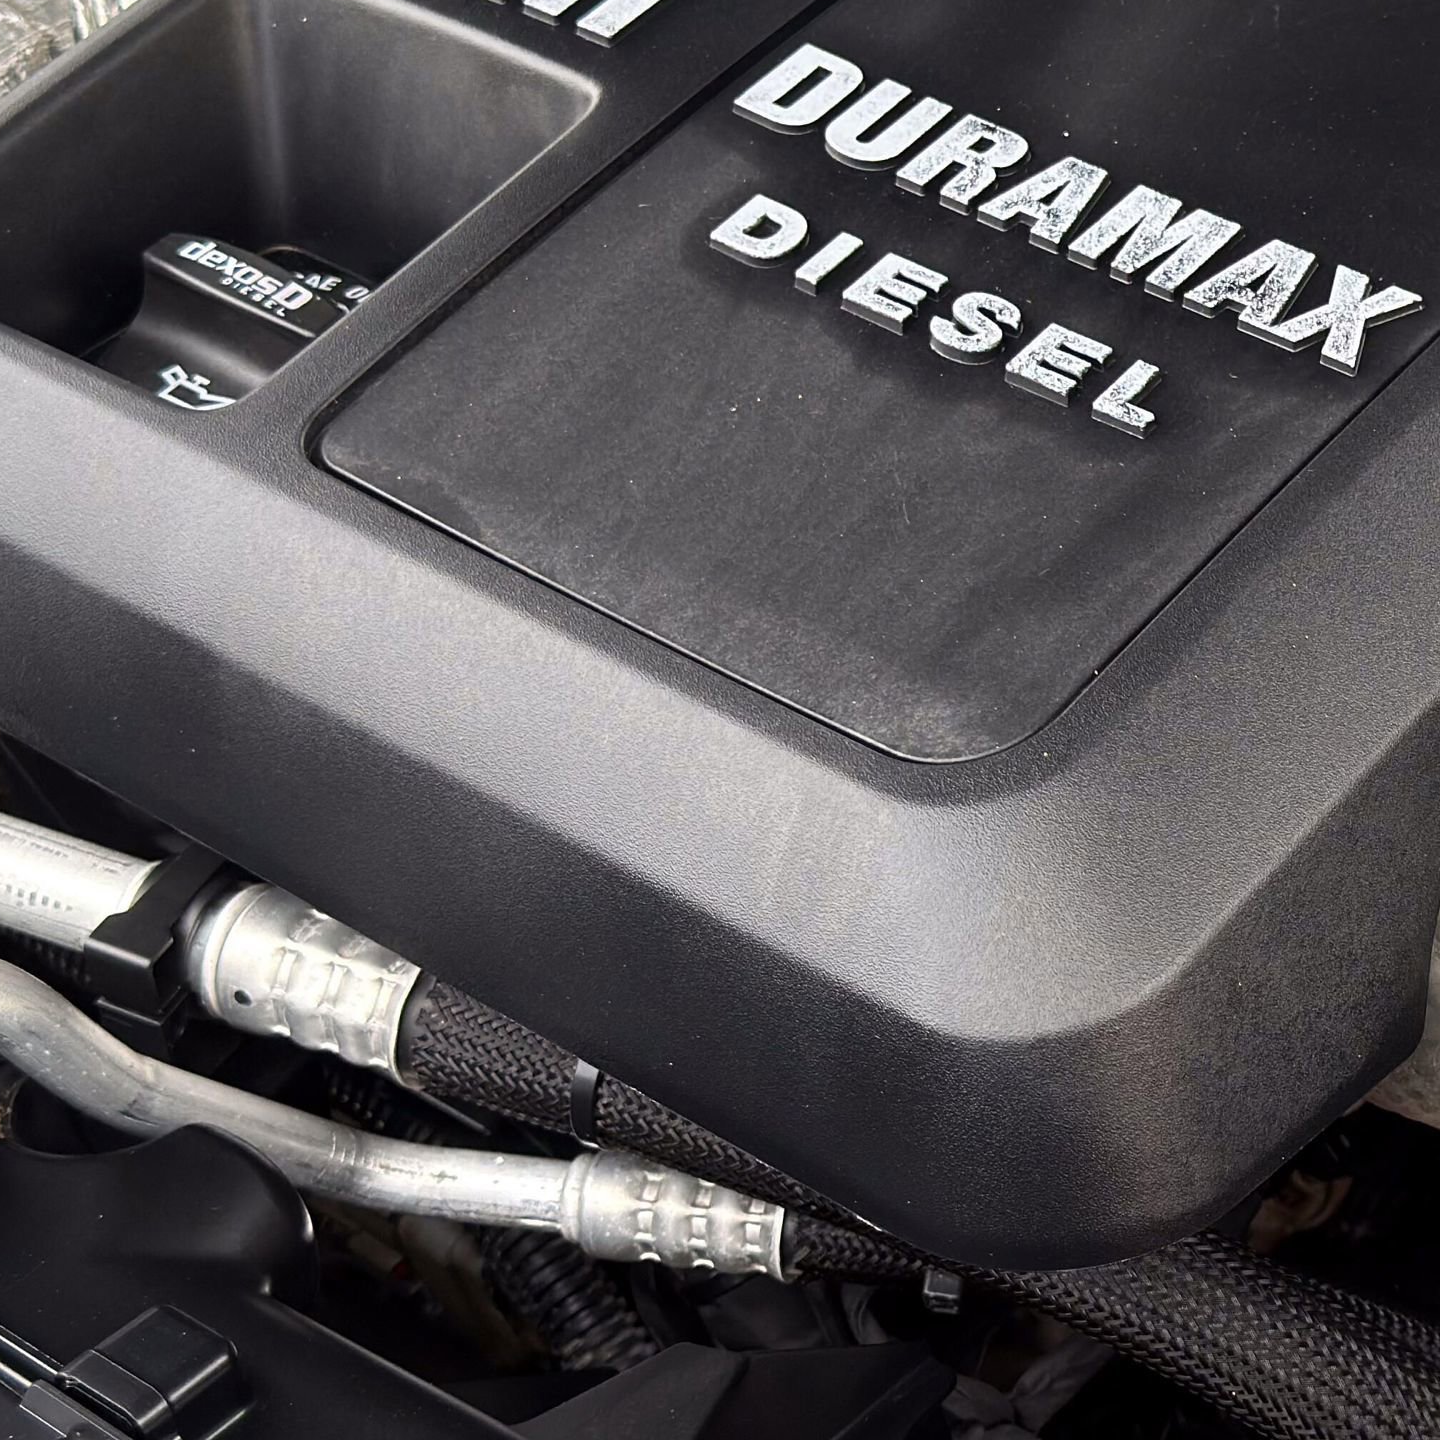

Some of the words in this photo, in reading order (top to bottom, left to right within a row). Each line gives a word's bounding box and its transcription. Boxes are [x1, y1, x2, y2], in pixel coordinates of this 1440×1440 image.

[219, 275, 287, 317] DIESEL
[709, 193, 1161, 440] DIESEL
[733, 43, 1423, 376] DURAMAX
